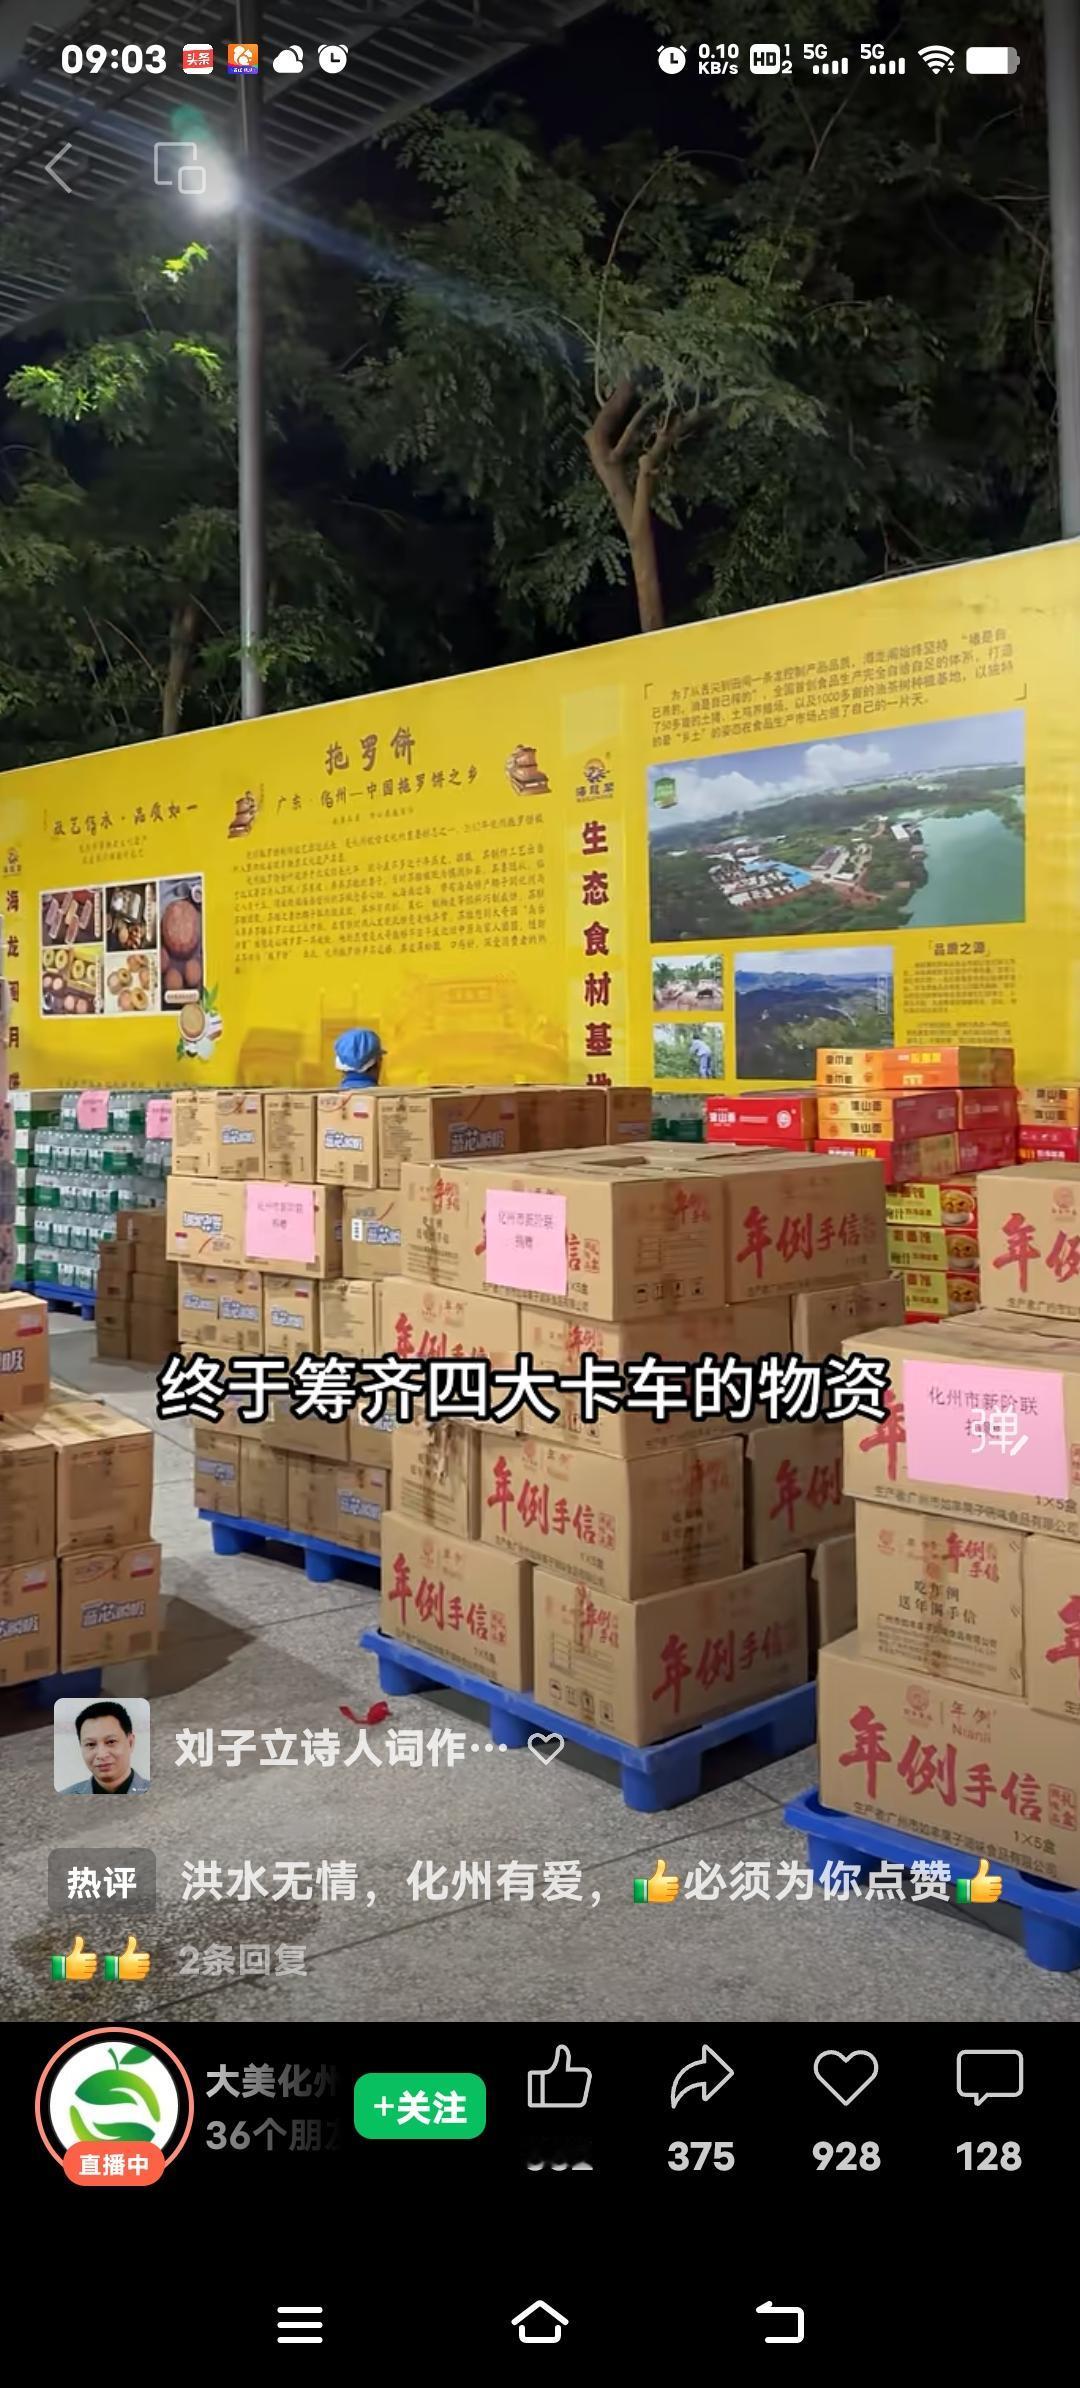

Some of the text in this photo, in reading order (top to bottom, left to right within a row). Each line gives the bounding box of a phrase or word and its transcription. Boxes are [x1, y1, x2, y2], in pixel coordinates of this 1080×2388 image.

[324, 727, 415, 776] 拖罗饼
[582, 820, 612, 1087] 生态食材基
[487, 1455, 596, 1544] 年例手信
[388, 1552, 488, 1641] 年例手信
[838, 1705, 1043, 1824] 年例手信
